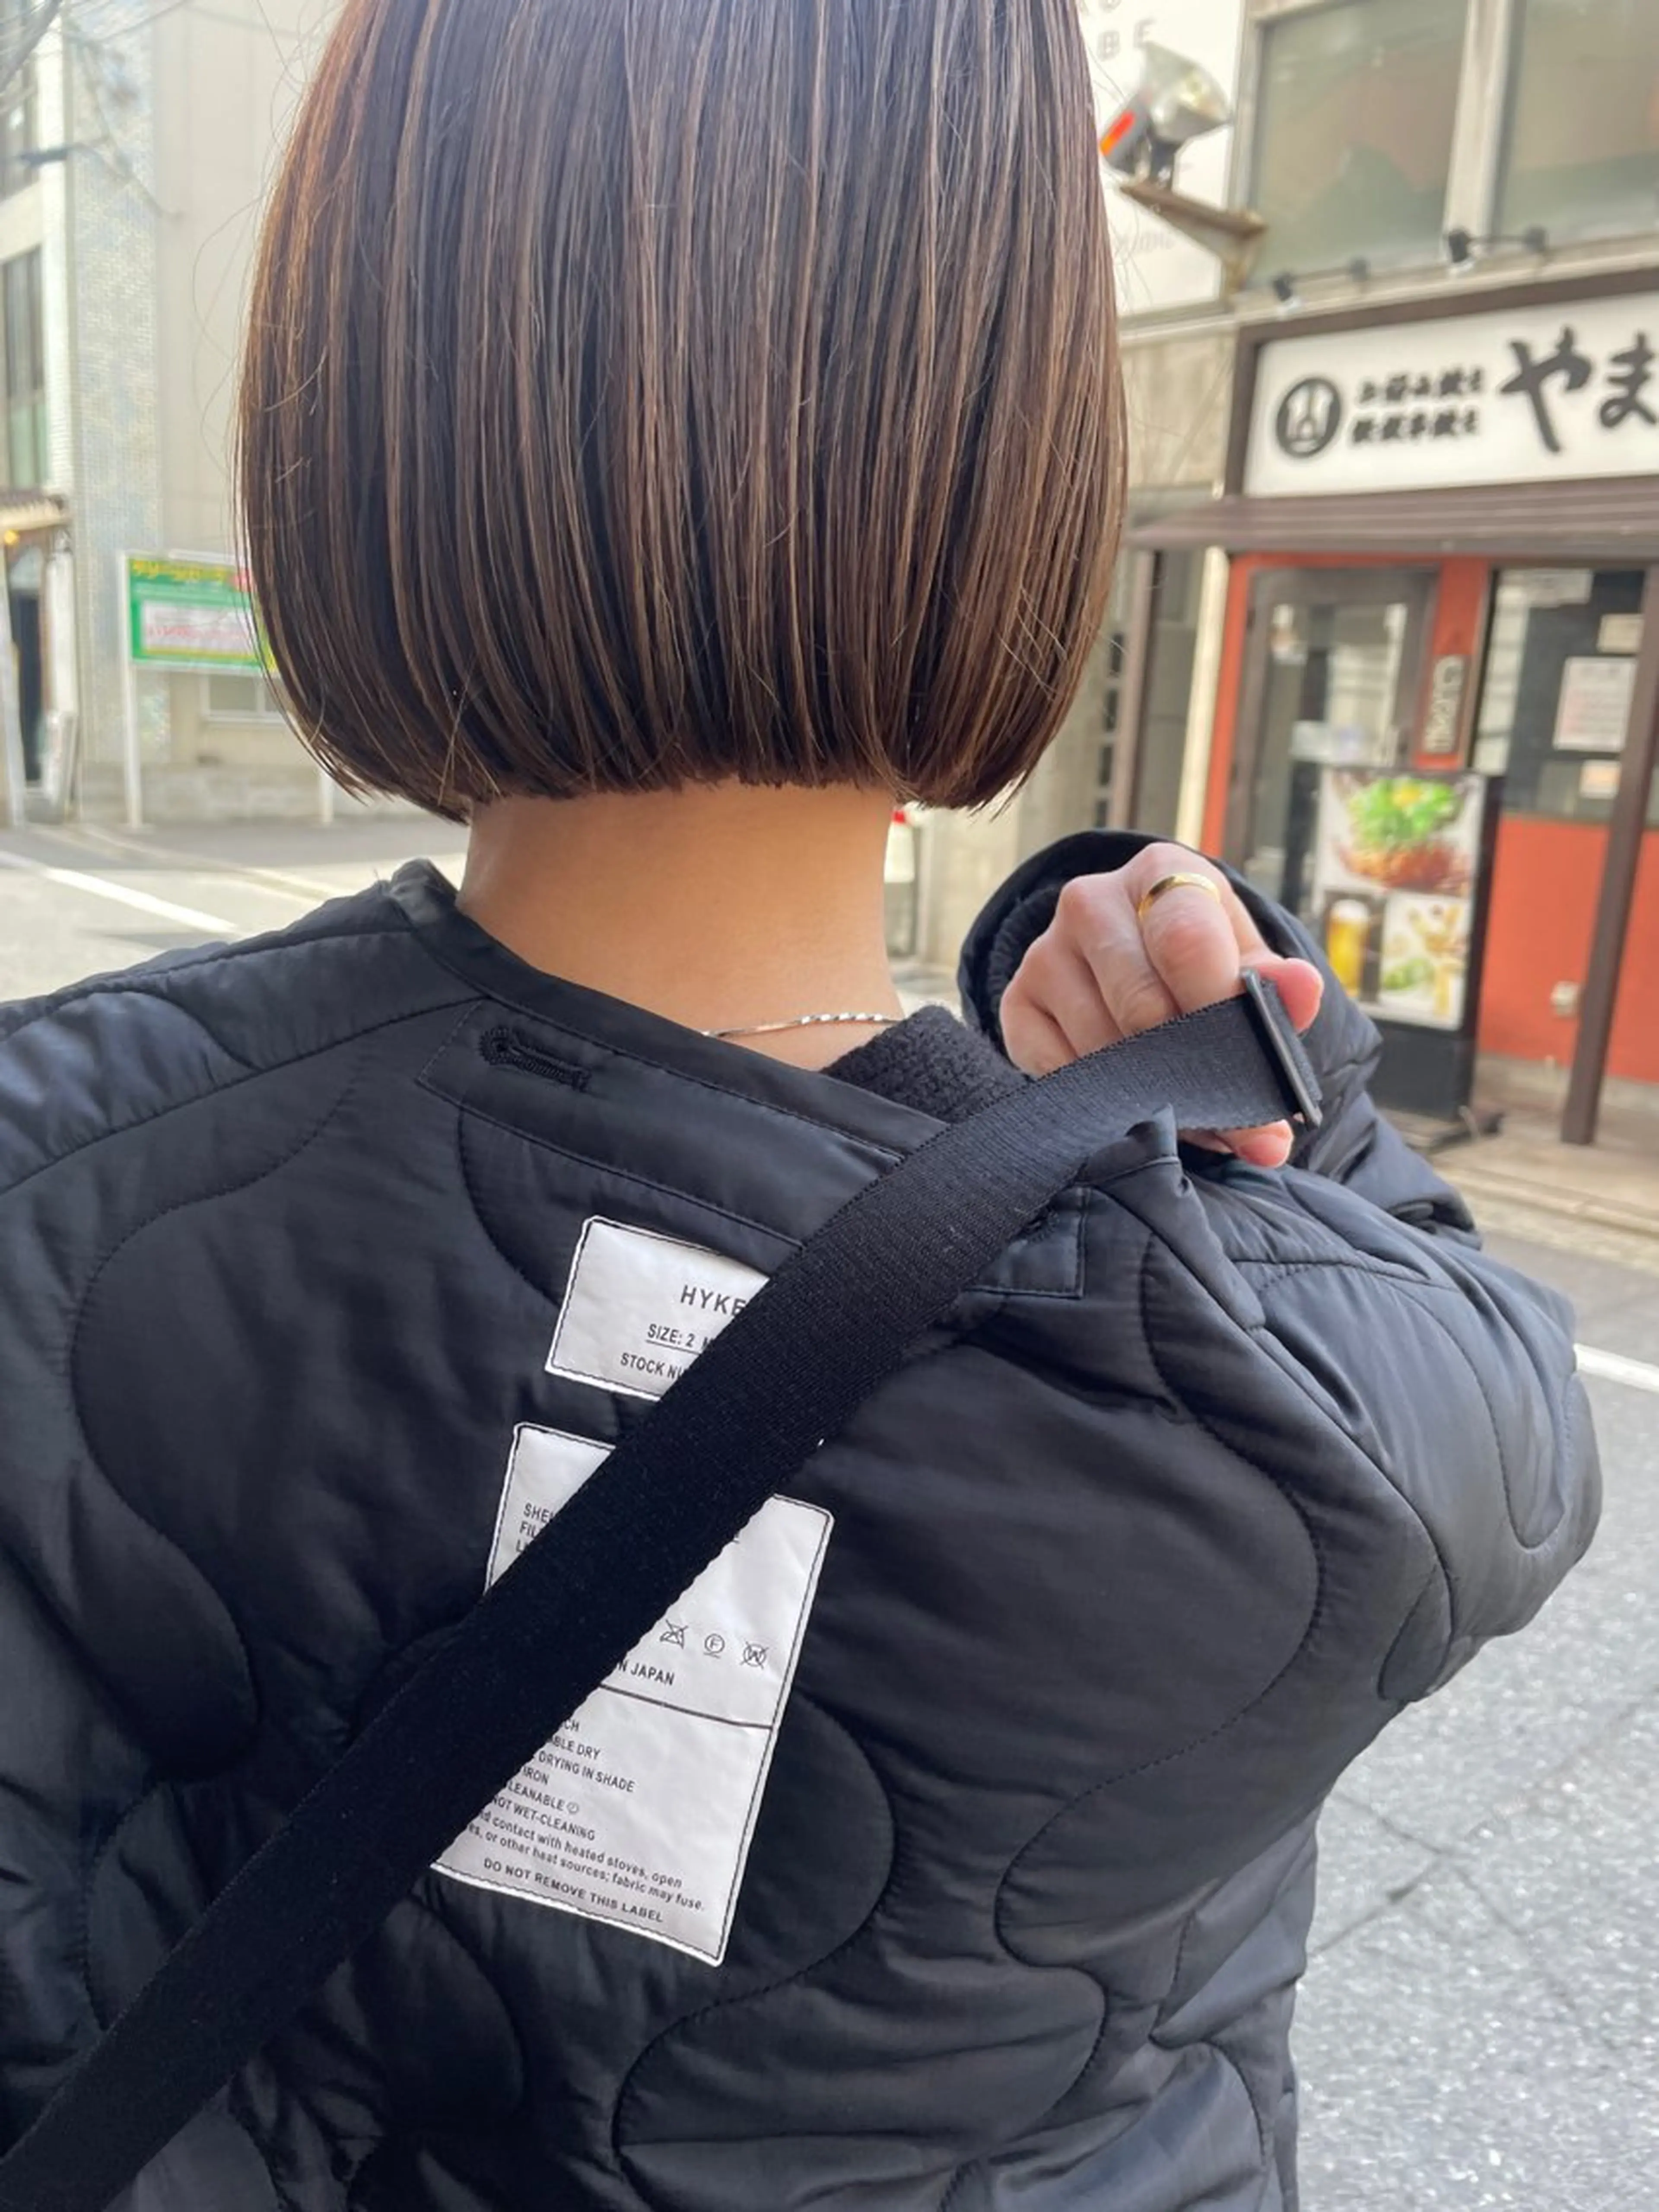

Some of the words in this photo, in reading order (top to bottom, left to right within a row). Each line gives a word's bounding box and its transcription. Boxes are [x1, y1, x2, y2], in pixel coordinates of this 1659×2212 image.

[1498, 326, 1657, 453] やま
[680, 1284, 746, 1316] HYKE
[648, 1323, 682, 1345] SIZE:
[685, 1333, 696, 1348] 2
[620, 1352, 665, 1376] STOCK
[631, 1662, 674, 1686] JAPAN
[539, 1750, 579, 1774] DRYING
[582, 1765, 594, 1780] IN
[595, 1771, 635, 1792] SHADE
[577, 1744, 600, 1760] DRY
[514, 1803, 595, 1841] WET-CLEANING
[485, 1832, 498, 1842] or
[500, 1837, 531, 1854] other
[533, 1847, 558, 1864] heat
[613, 1872, 646, 1893] fabric
[648, 1887, 673, 1903] may
[676, 1893, 704, 1910] fuse.
[493, 1816, 535, 1840] contact
[538, 1833, 561, 1850] with
[564, 1841, 605, 1863] heated
[607, 1857, 647, 1880] stoves,
[652, 1872, 682, 1888] open
[484, 1858, 502, 1872] DO
[505, 1865, 531, 1879] NOT
[534, 1872, 587, 1899] REMOVE
[590, 1892, 618, 1909] THIS
[622, 1903, 663, 1923] LABEL
